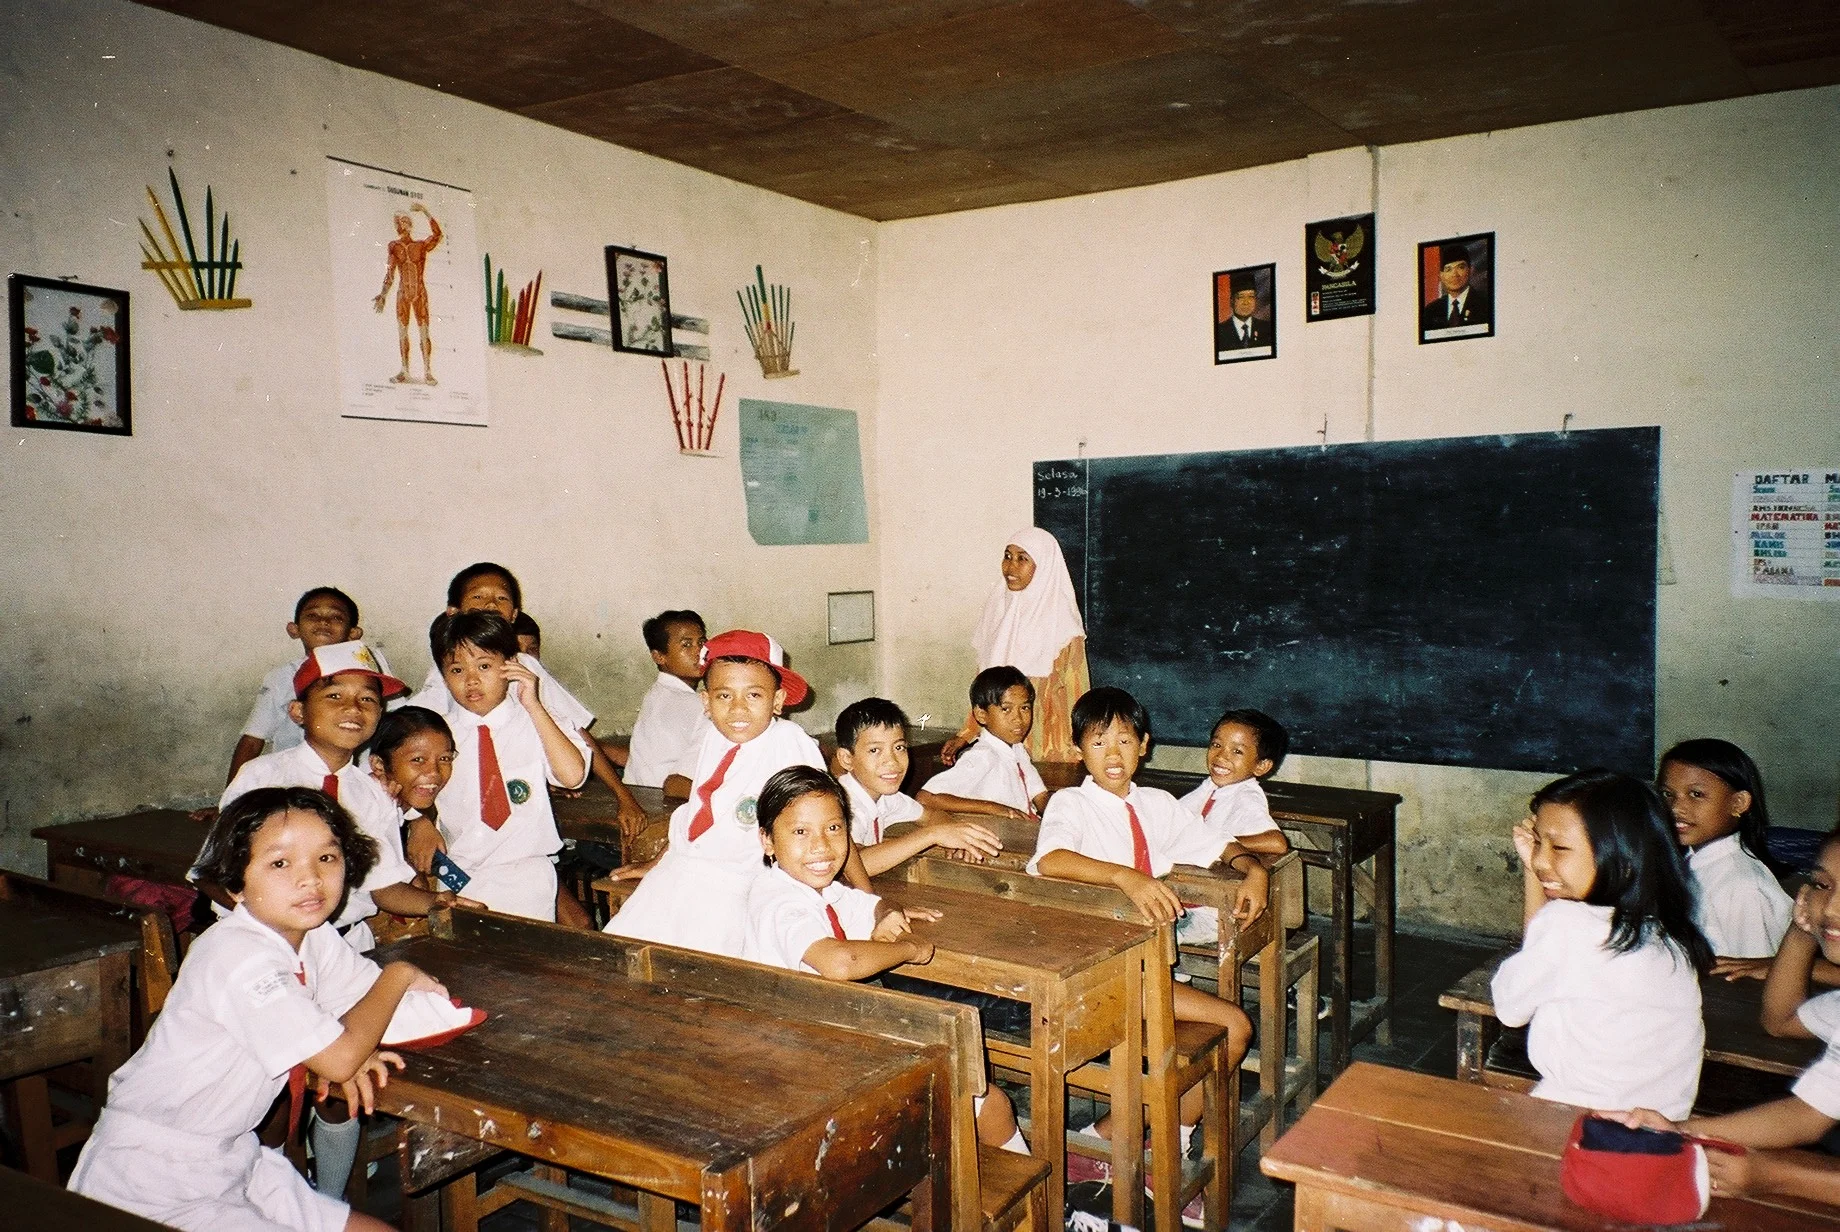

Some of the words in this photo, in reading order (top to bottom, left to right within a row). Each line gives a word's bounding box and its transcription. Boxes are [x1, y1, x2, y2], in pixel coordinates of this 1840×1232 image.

[1321, 280, 1357, 290] PANCASILA
[1037, 468, 1078, 481] Selasa
[1754, 473, 1810, 484] DAFTAR
[1751, 513, 1819, 521] MATEMATIKA
